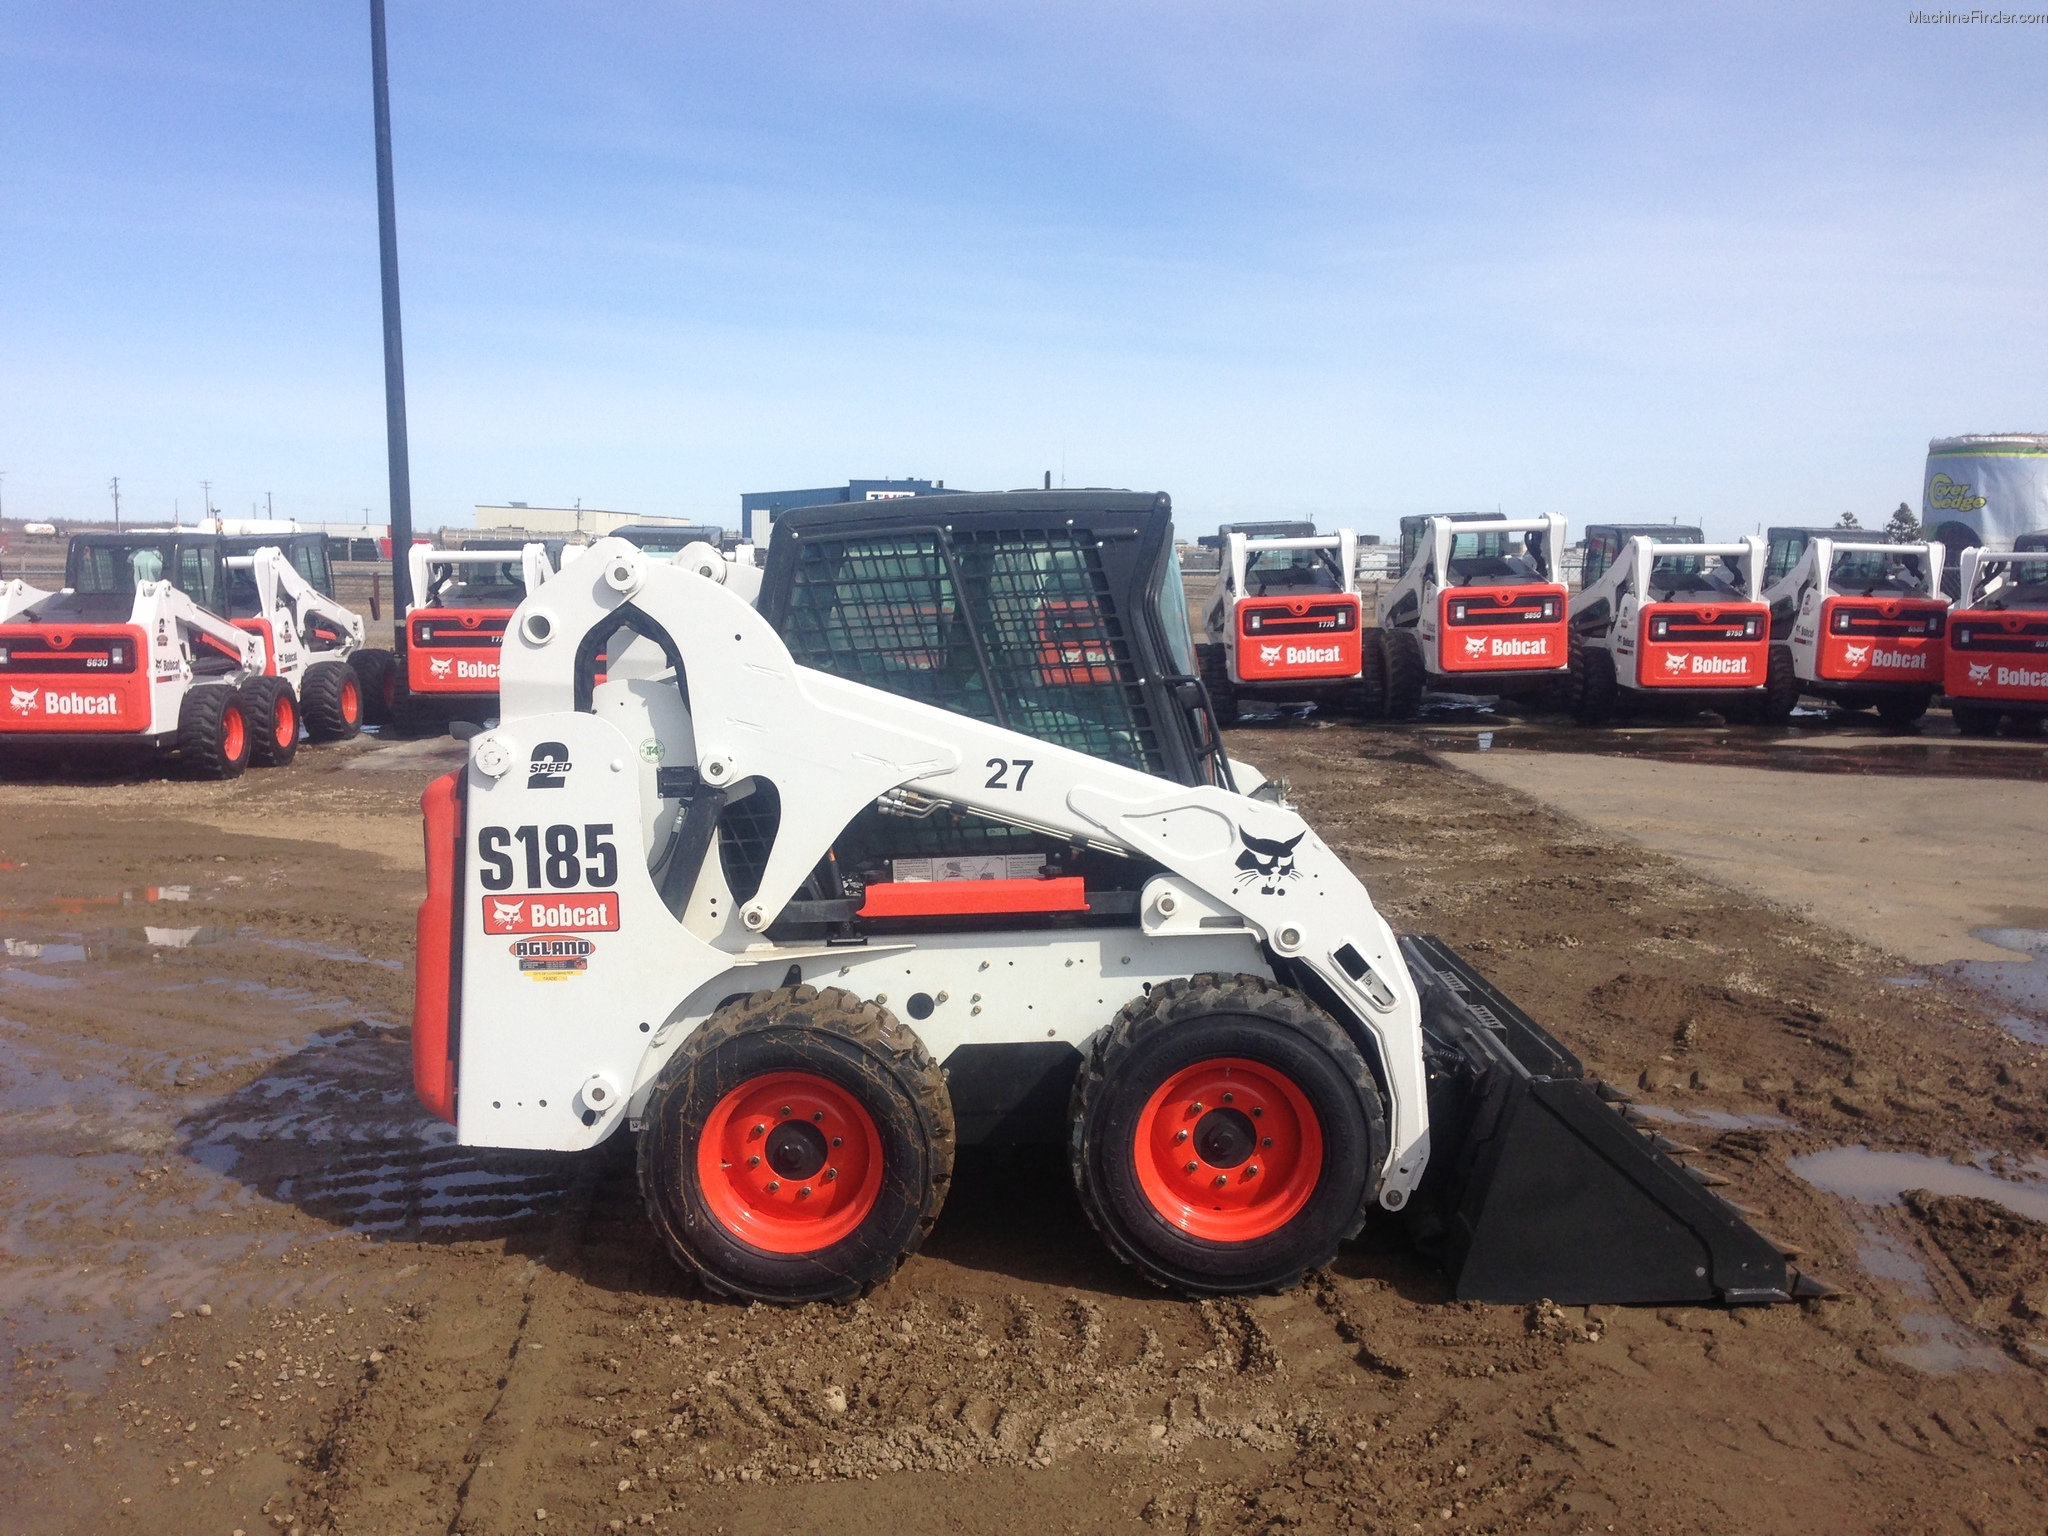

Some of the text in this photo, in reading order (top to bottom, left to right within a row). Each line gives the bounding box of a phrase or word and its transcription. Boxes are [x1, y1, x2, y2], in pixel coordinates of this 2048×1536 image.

[1286, 645, 1341, 664] Bobcat
[1491, 638, 1547, 656] Bobcat
[86, 658, 109, 668] S630
[1691, 655, 1748, 673] Bobcat
[1871, 649, 1927, 669] Bobcat
[45, 691, 118, 715] Bobcat
[529, 762, 572, 773] SPEED
[984, 757, 1034, 792] 27
[478, 823, 618, 891] S185
[530, 903, 608, 928] Bobcat
[516, 940, 591, 956] AGLAND
